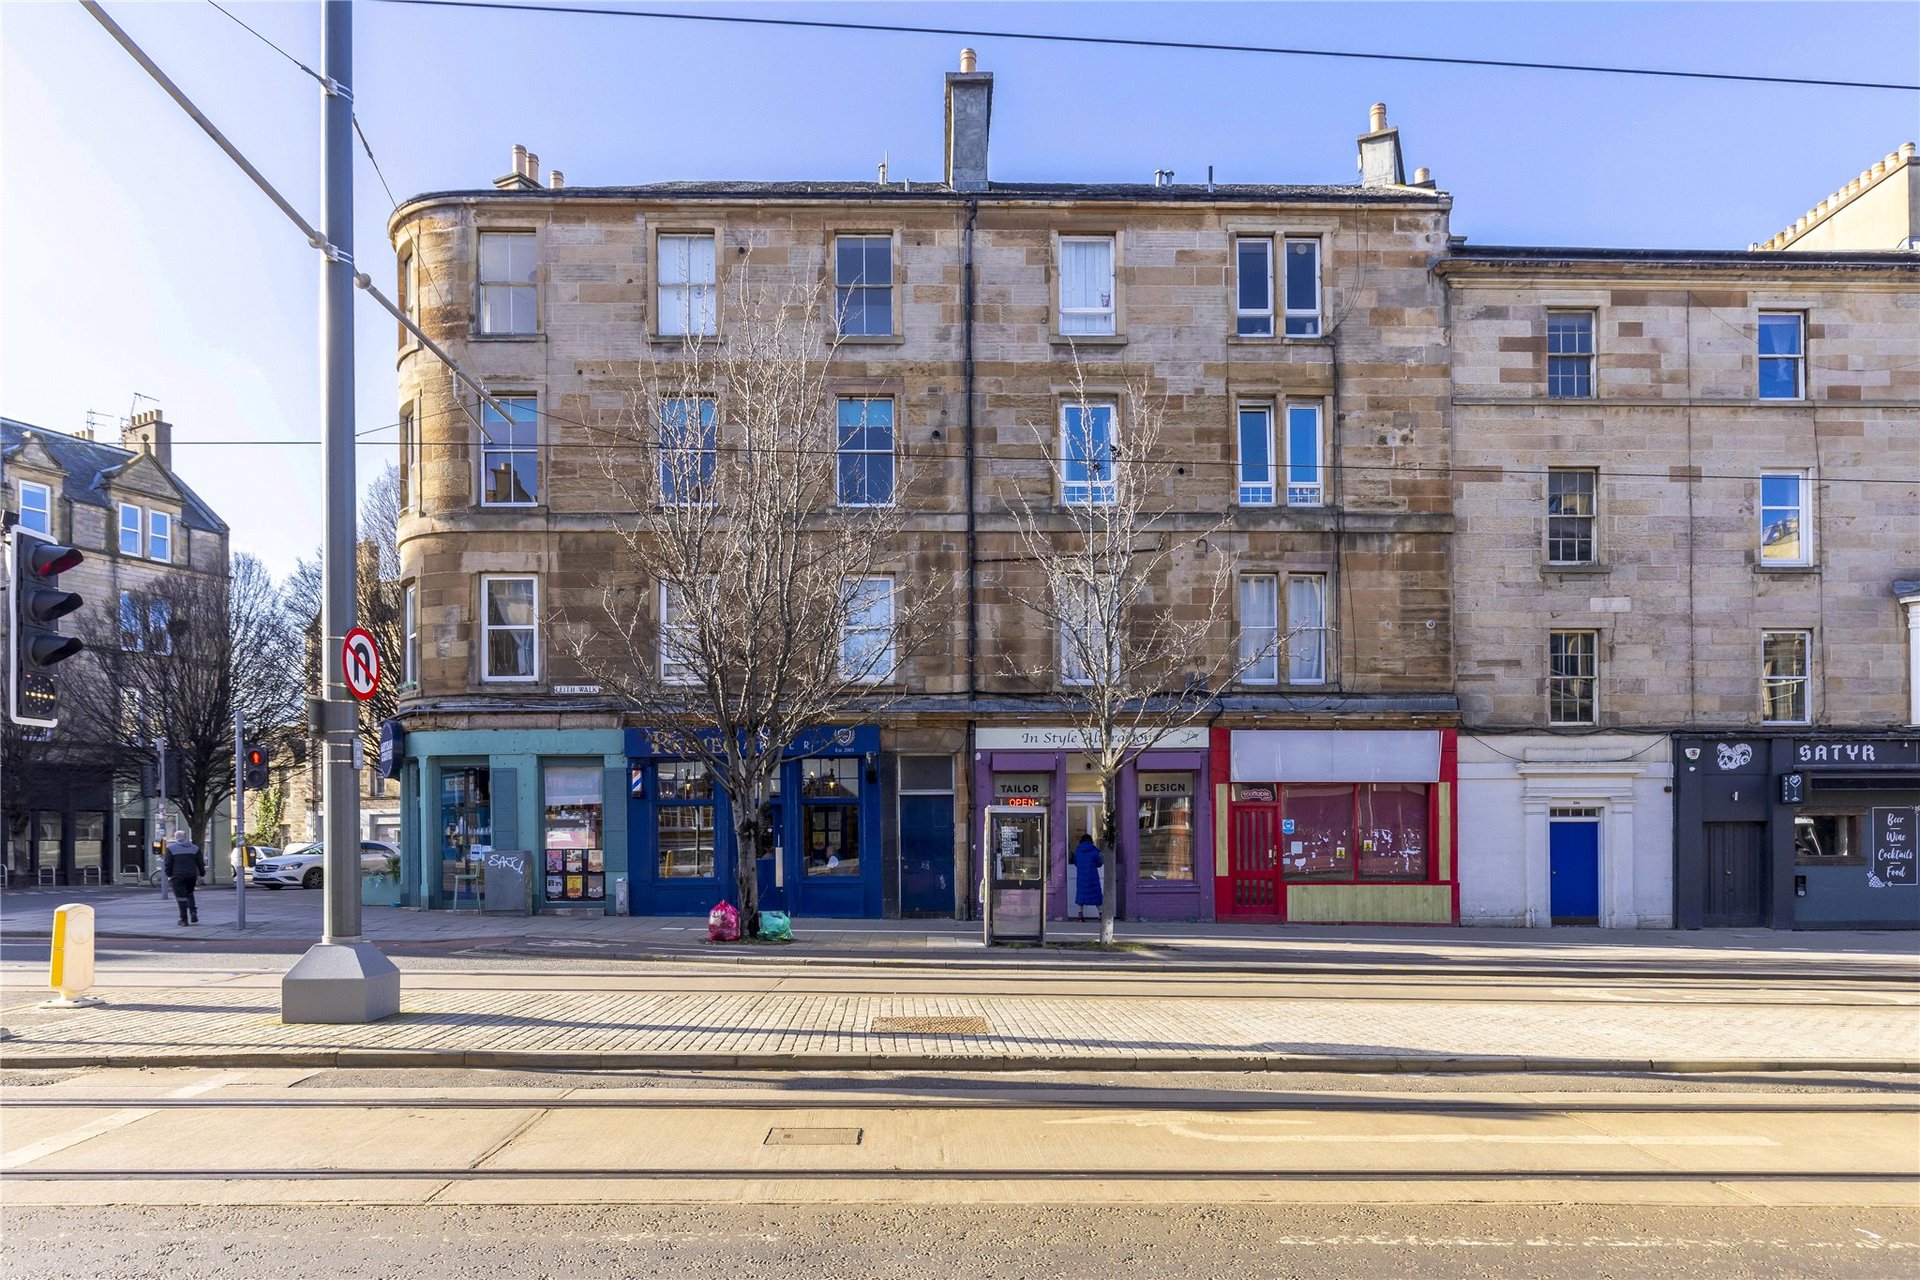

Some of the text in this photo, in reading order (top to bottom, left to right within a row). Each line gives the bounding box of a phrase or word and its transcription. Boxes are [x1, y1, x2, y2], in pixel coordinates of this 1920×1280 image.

[1021, 732, 1038, 744] In
[1044, 732, 1077, 747] Style
[1799, 744, 1876, 761] SATYR
[1001, 784, 1039, 793] TAILOR
[1145, 783, 1186, 792] DESIGN
[1009, 798, 1035, 807] OPEN
[1887, 812, 1905, 826] Beer
[1886, 831, 1906, 843] Wine
[1878, 848, 1913, 861] Cocktails
[1886, 865, 1906, 878] Food
